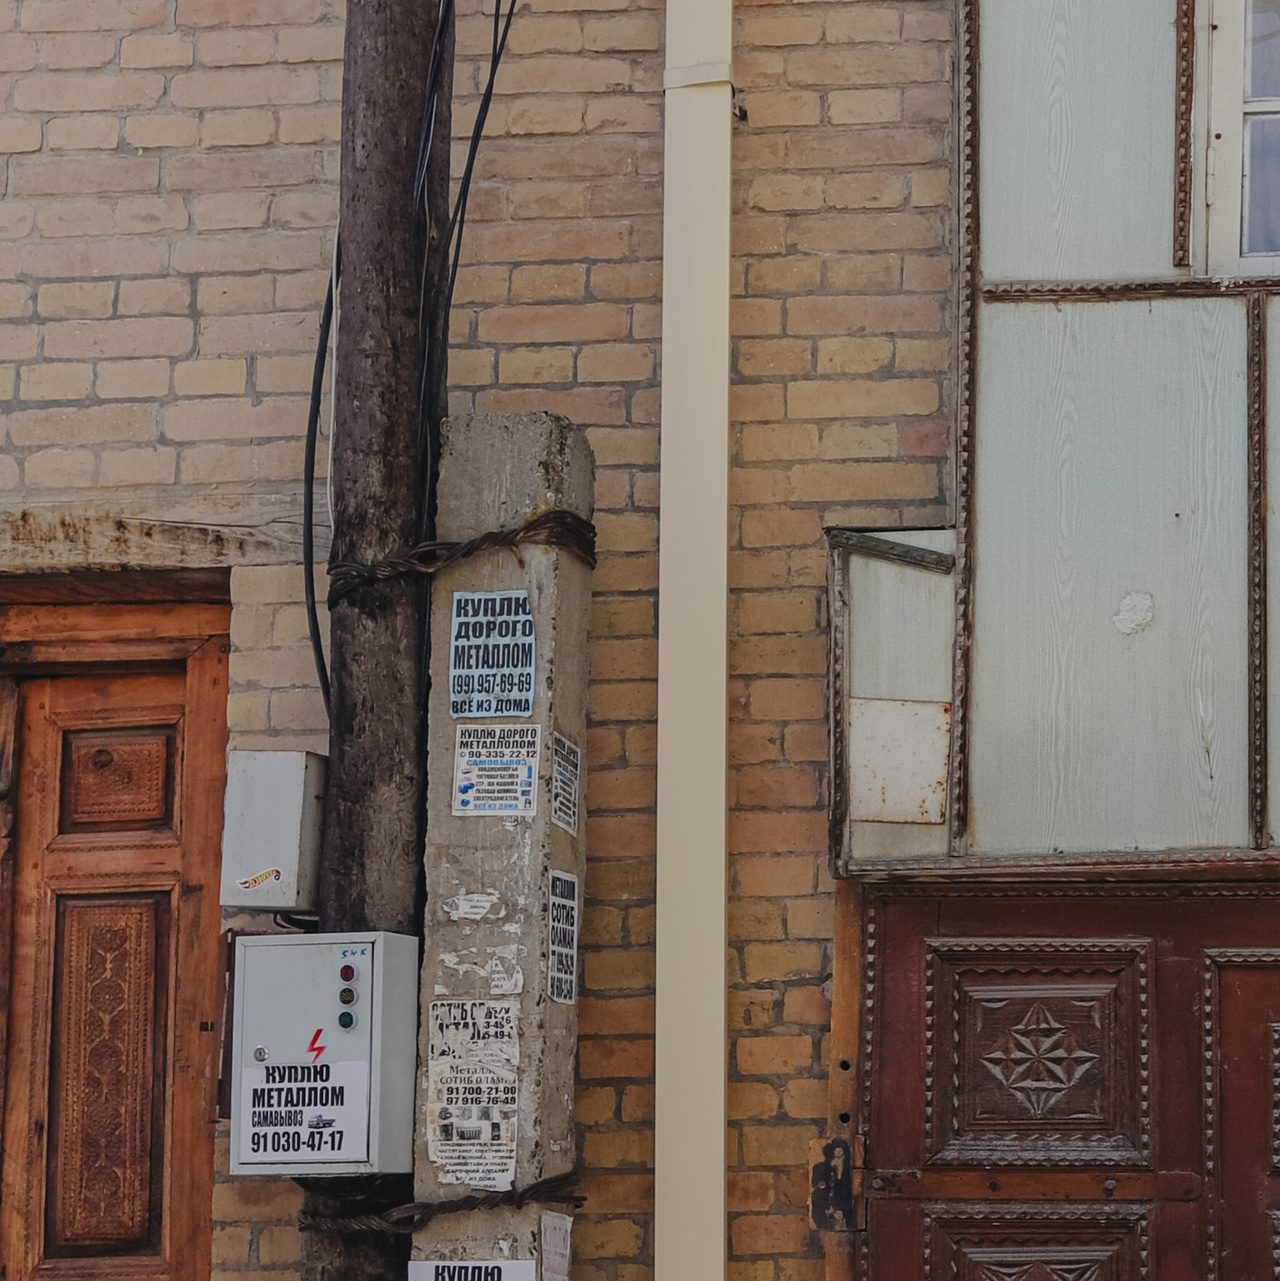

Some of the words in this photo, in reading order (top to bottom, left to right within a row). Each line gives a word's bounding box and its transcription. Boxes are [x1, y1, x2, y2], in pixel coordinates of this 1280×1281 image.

[456, 597, 531, 618] КУПЛЮ
[455, 619, 534, 641] ДОРОГО
[453, 642, 533, 670] МЕТАЛЛОМ
[452, 675, 475, 695] (99)
[477, 672, 532, 694] 957-69-69
[476, 699, 492, 713] ИЗ
[494, 698, 530, 714] ДОМА
[460, 729, 496, 740] КУПЛЮ
[498, 728, 537, 741] ДОРОГО
[459, 740, 536, 750] МЕТАЛЛОЛОМ
[468, 750, 537, 759] 90-335-22-12
[466, 759, 528, 767] САМОВЫВОЗ
[551, 901, 575, 927] СОТИБ
[265, 1064, 331, 1084] КУПЛЮ
[440, 1076, 474, 1085] СОТИБ
[252, 1086, 345, 1108] МЕТАЛЛОМ
[446, 1086, 460, 1096] 91
[461, 1085, 517, 1096] 700-21-00
[446, 1096, 460, 1106] 97
[461, 1096, 517, 1106] 916-76-49
[251, 1109, 304, 1128] САМАВЫВОЗ
[251, 1131, 268, 1153] 91
[271, 1130, 344, 1152] 030-47-17
